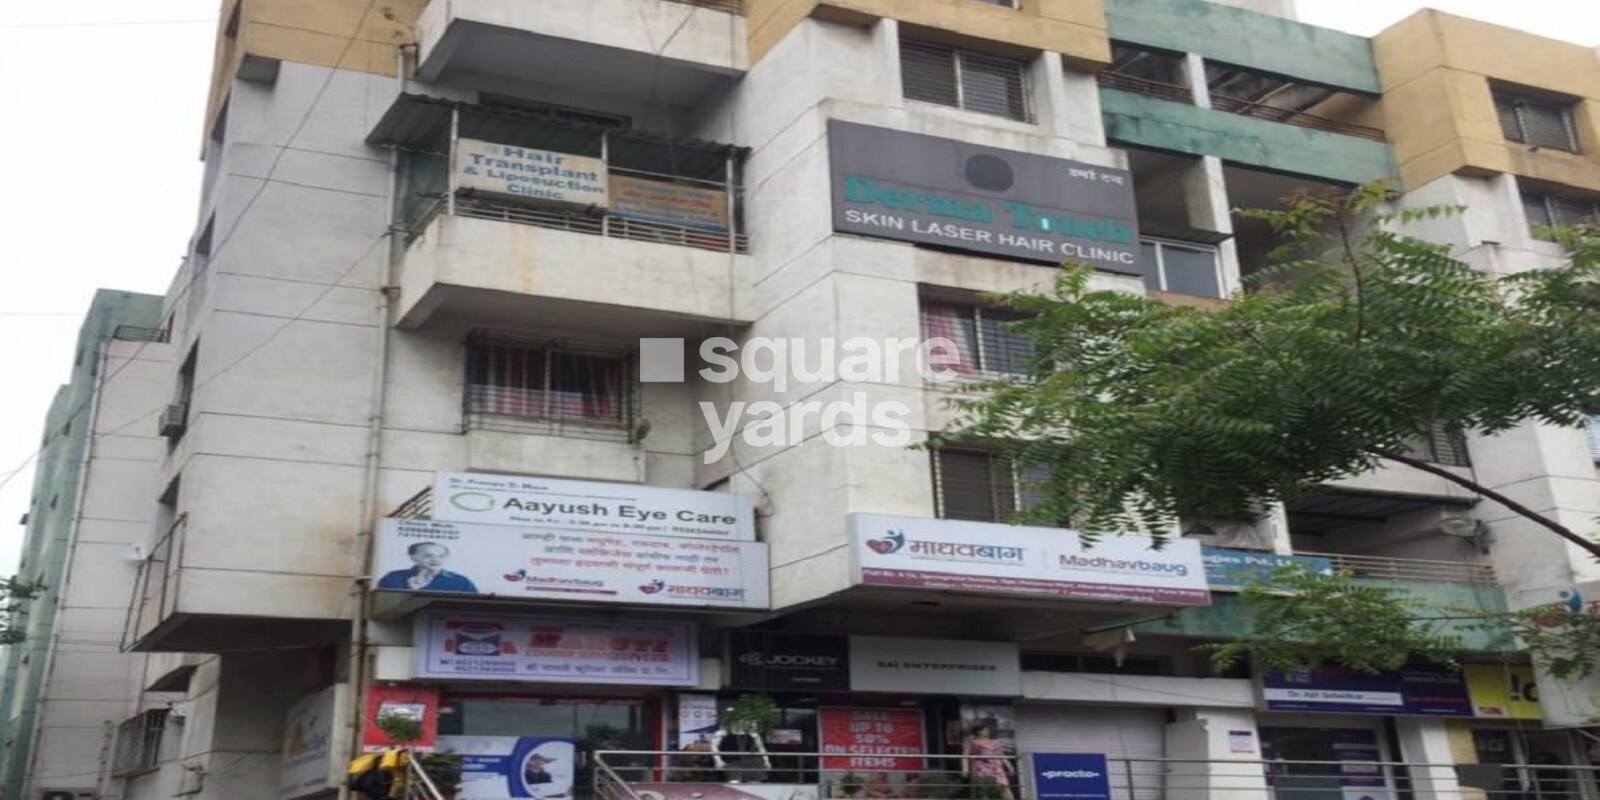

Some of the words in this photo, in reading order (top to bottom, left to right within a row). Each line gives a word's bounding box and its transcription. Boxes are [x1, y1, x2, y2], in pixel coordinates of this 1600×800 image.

[503, 147, 566, 164] Hair
[469, 153, 599, 181] Transplant
[487, 170, 604, 194] Liposuction
[507, 184, 565, 199] Clinic
[843, 174, 993, 222] Derma
[844, 209, 904, 230] SKIN
[912, 219, 993, 244] LASER
[998, 233, 1054, 254] HAIR
[1060, 243, 1136, 264] CLINIC
[503, 497, 609, 516] Aayush
[619, 505, 667, 521] Eye
[676, 510, 738, 525] Care
[908, 540, 1029, 560] माधवबाग
[1059, 554, 1188, 576] Madhavbaug
[767, 655, 838, 666] JOCKEY
[903, 662, 997, 671] ENTERPRISES
[852, 722, 870, 733] UP
[875, 722, 893, 733] TO
[855, 734, 890, 744] 50%
[850, 757, 897, 767] ITEMS
